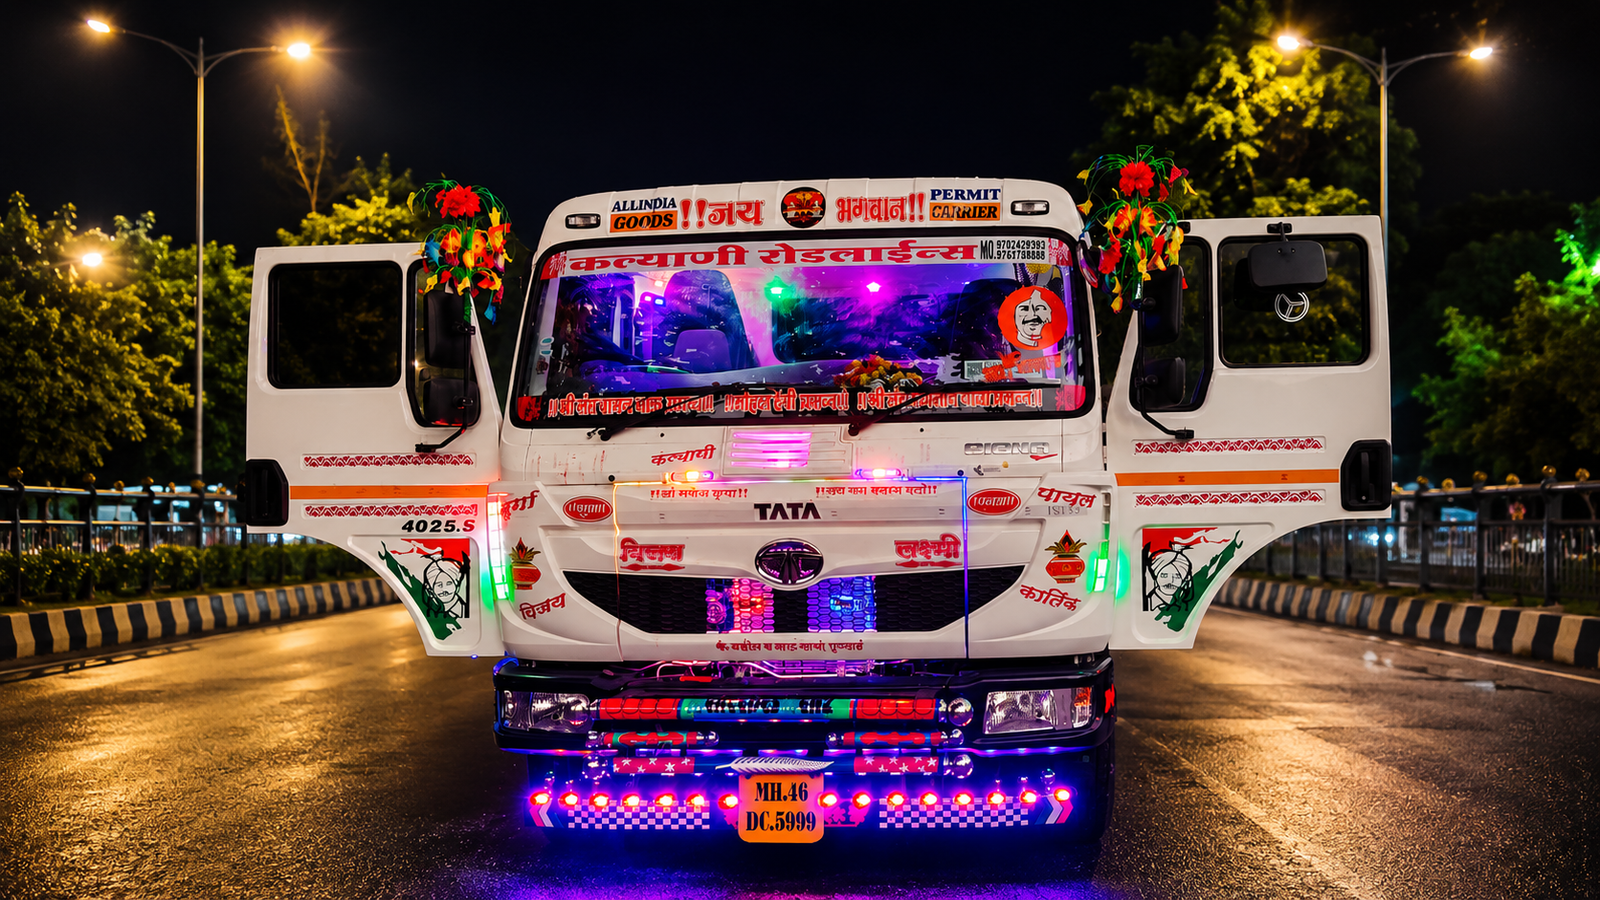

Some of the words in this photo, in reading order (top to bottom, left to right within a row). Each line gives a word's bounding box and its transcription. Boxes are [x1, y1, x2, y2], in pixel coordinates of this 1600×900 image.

[930, 188, 1001, 201] PERMIT
[613, 212, 674, 230] GOODS
[932, 204, 998, 220] CARRIER
[569, 244, 749, 272] कल्याणी
[754, 502, 822, 520] TATA
[401, 519, 476, 533] 4025.S
[754, 781, 809, 802] MH.46
[745, 811, 817, 832] DC.5999
